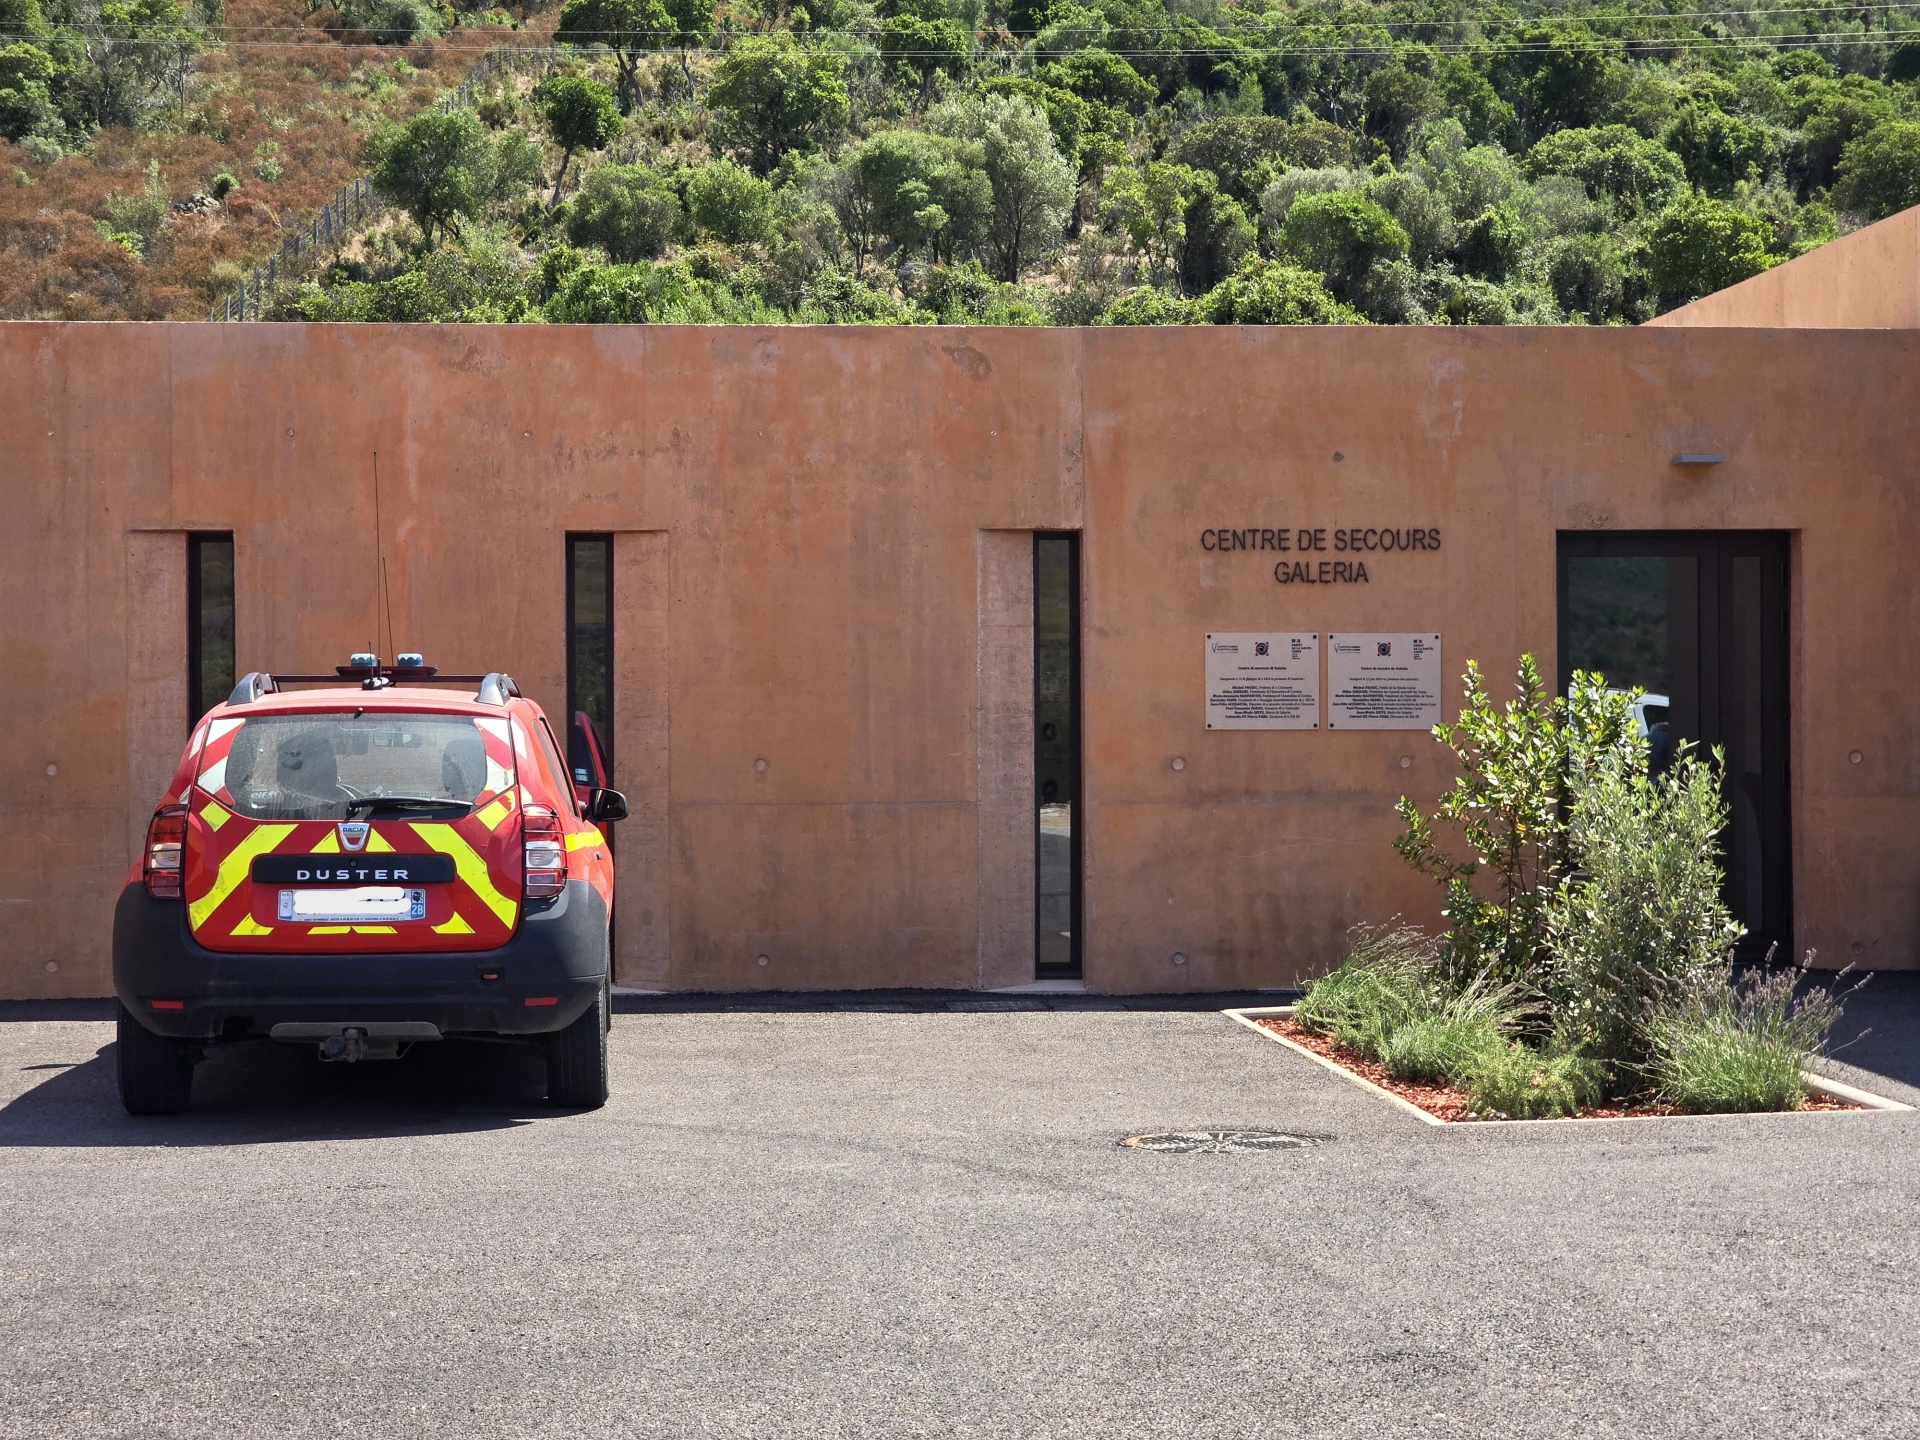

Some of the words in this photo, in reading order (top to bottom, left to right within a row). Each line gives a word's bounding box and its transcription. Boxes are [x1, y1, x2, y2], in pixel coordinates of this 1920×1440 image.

[1200, 528, 1291, 552] CENTRE
[1297, 528, 1327, 551] DE
[1334, 528, 1442, 551] SECOURS
[1273, 561, 1370, 584] GALERIA
[296, 869, 409, 880] DUSTER
[411, 904, 424, 916] 2B
